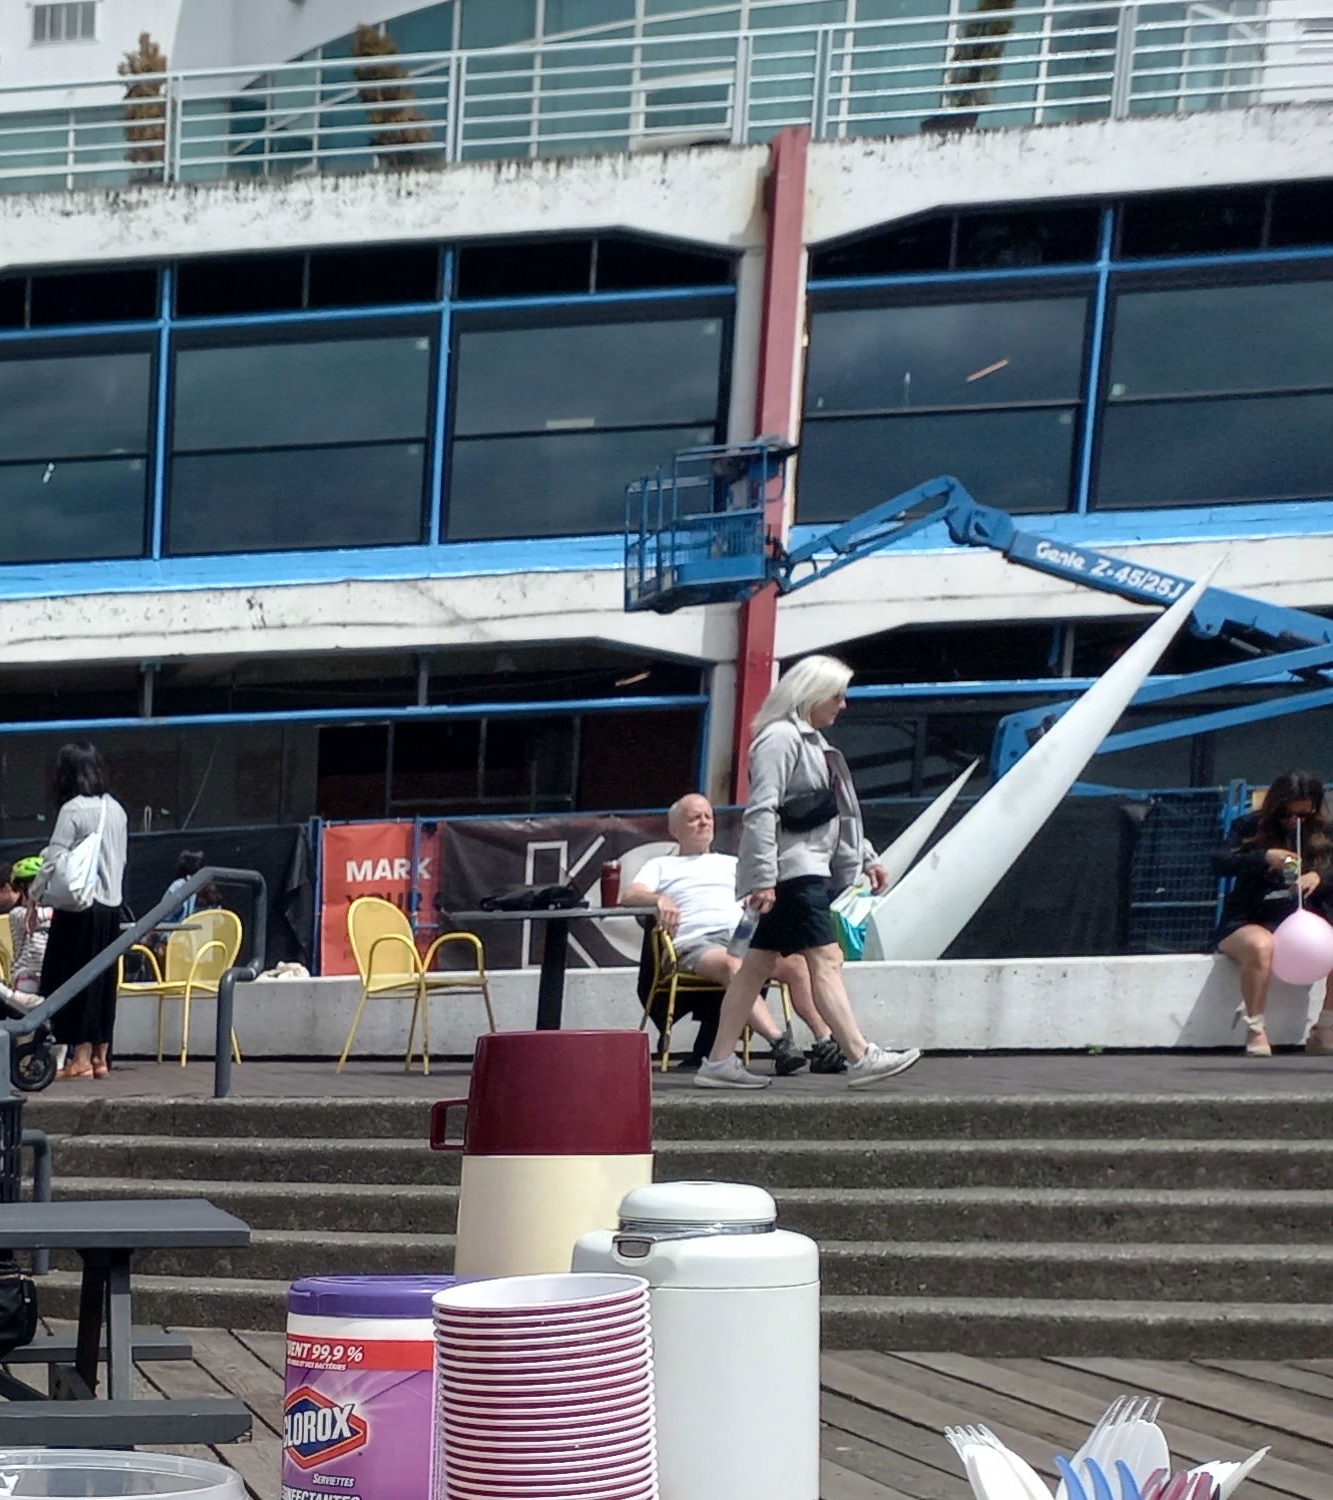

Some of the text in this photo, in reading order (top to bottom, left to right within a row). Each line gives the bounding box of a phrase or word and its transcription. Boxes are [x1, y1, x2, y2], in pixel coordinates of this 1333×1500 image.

[345, 857, 432, 883] MARK
[311, 1344, 344, 1363] 99,9
[347, 1346, 363, 1362] %
[313, 1474, 354, 1487] SERVIETTES
